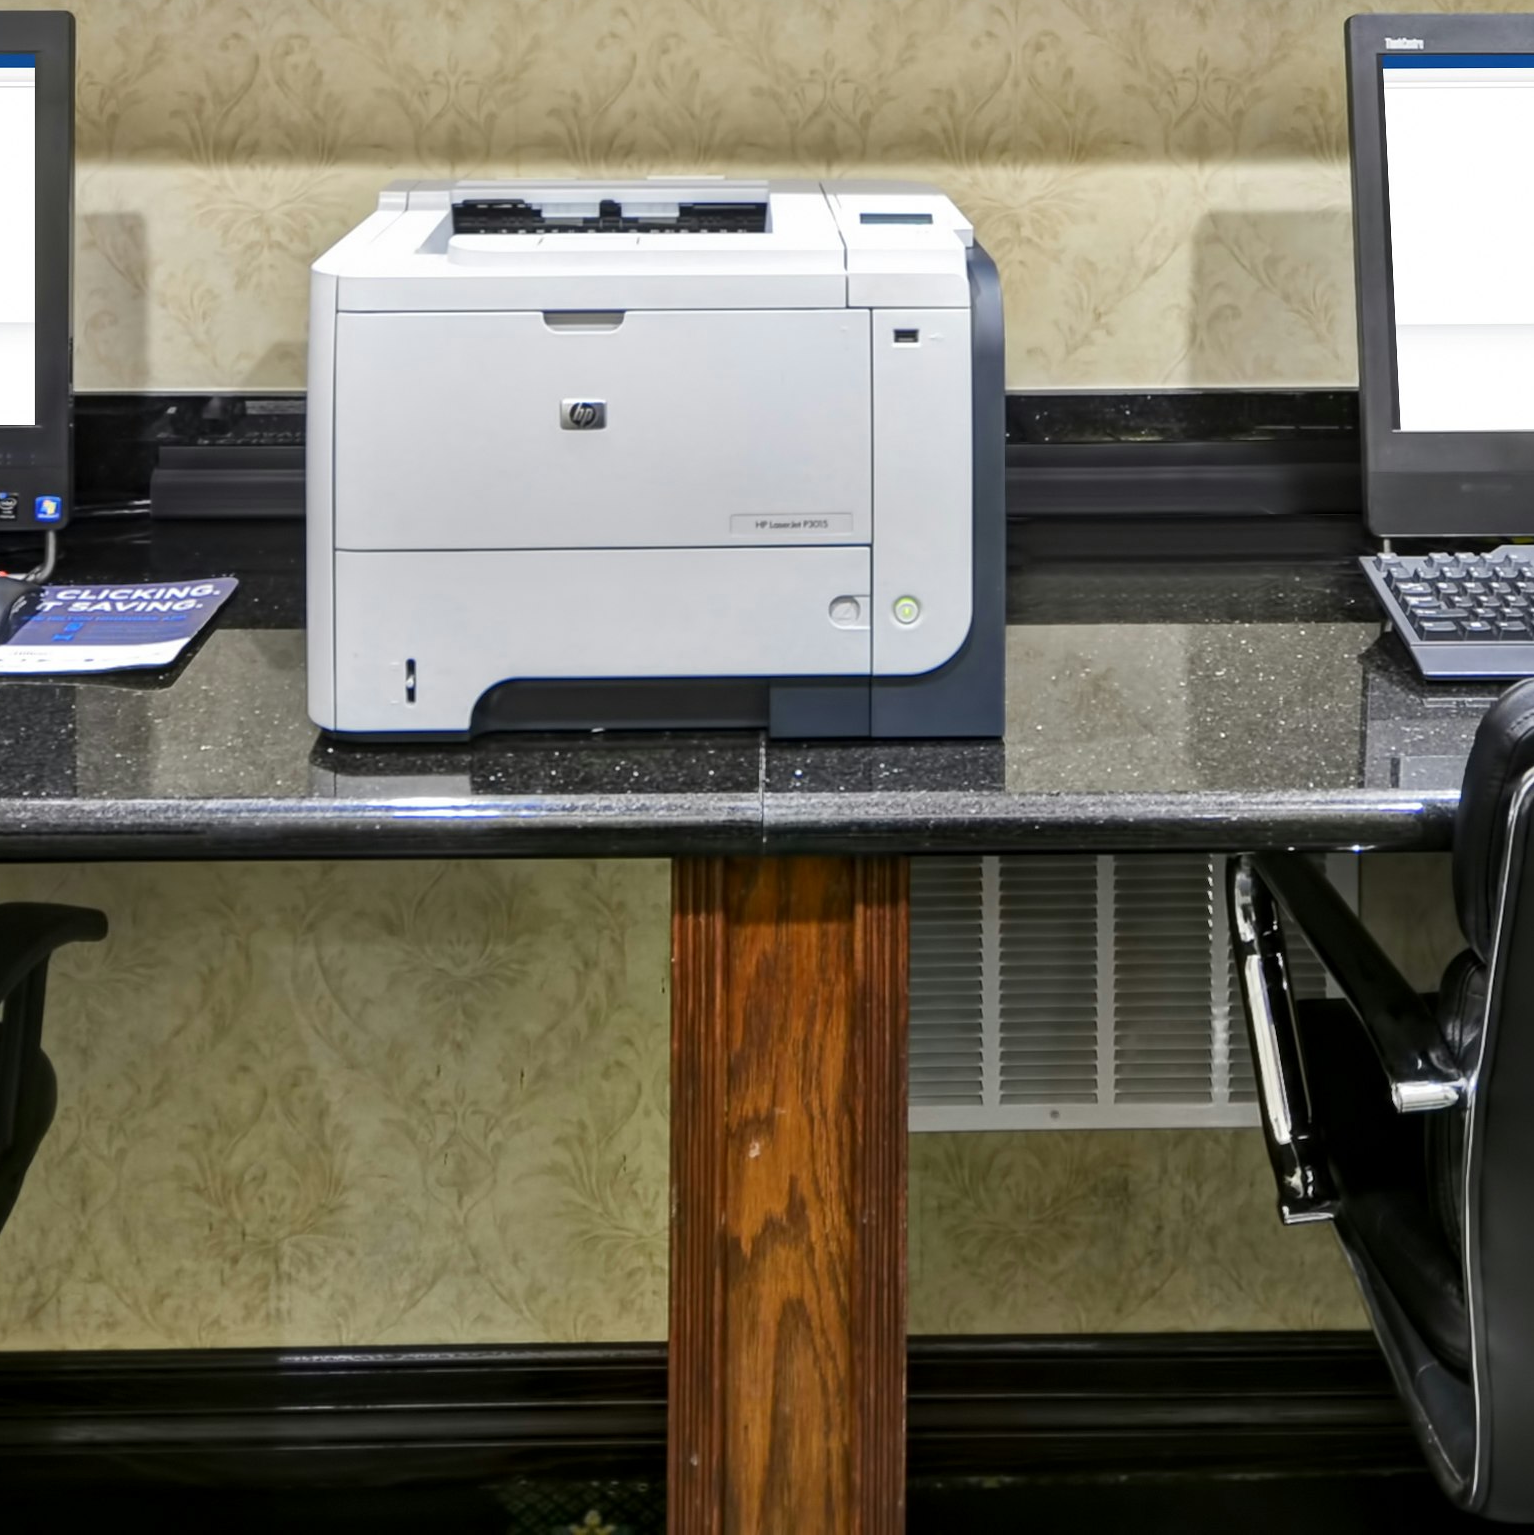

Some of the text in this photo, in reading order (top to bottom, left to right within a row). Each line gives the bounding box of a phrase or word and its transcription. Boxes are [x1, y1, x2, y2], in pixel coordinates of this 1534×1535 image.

[570, 402, 596, 426] hp
[755, 520, 768, 529] HP
[769, 520, 802, 529] LaserJet
[56, 584, 221, 601] CLICKING.
[67, 599, 204, 612] SAVING.
